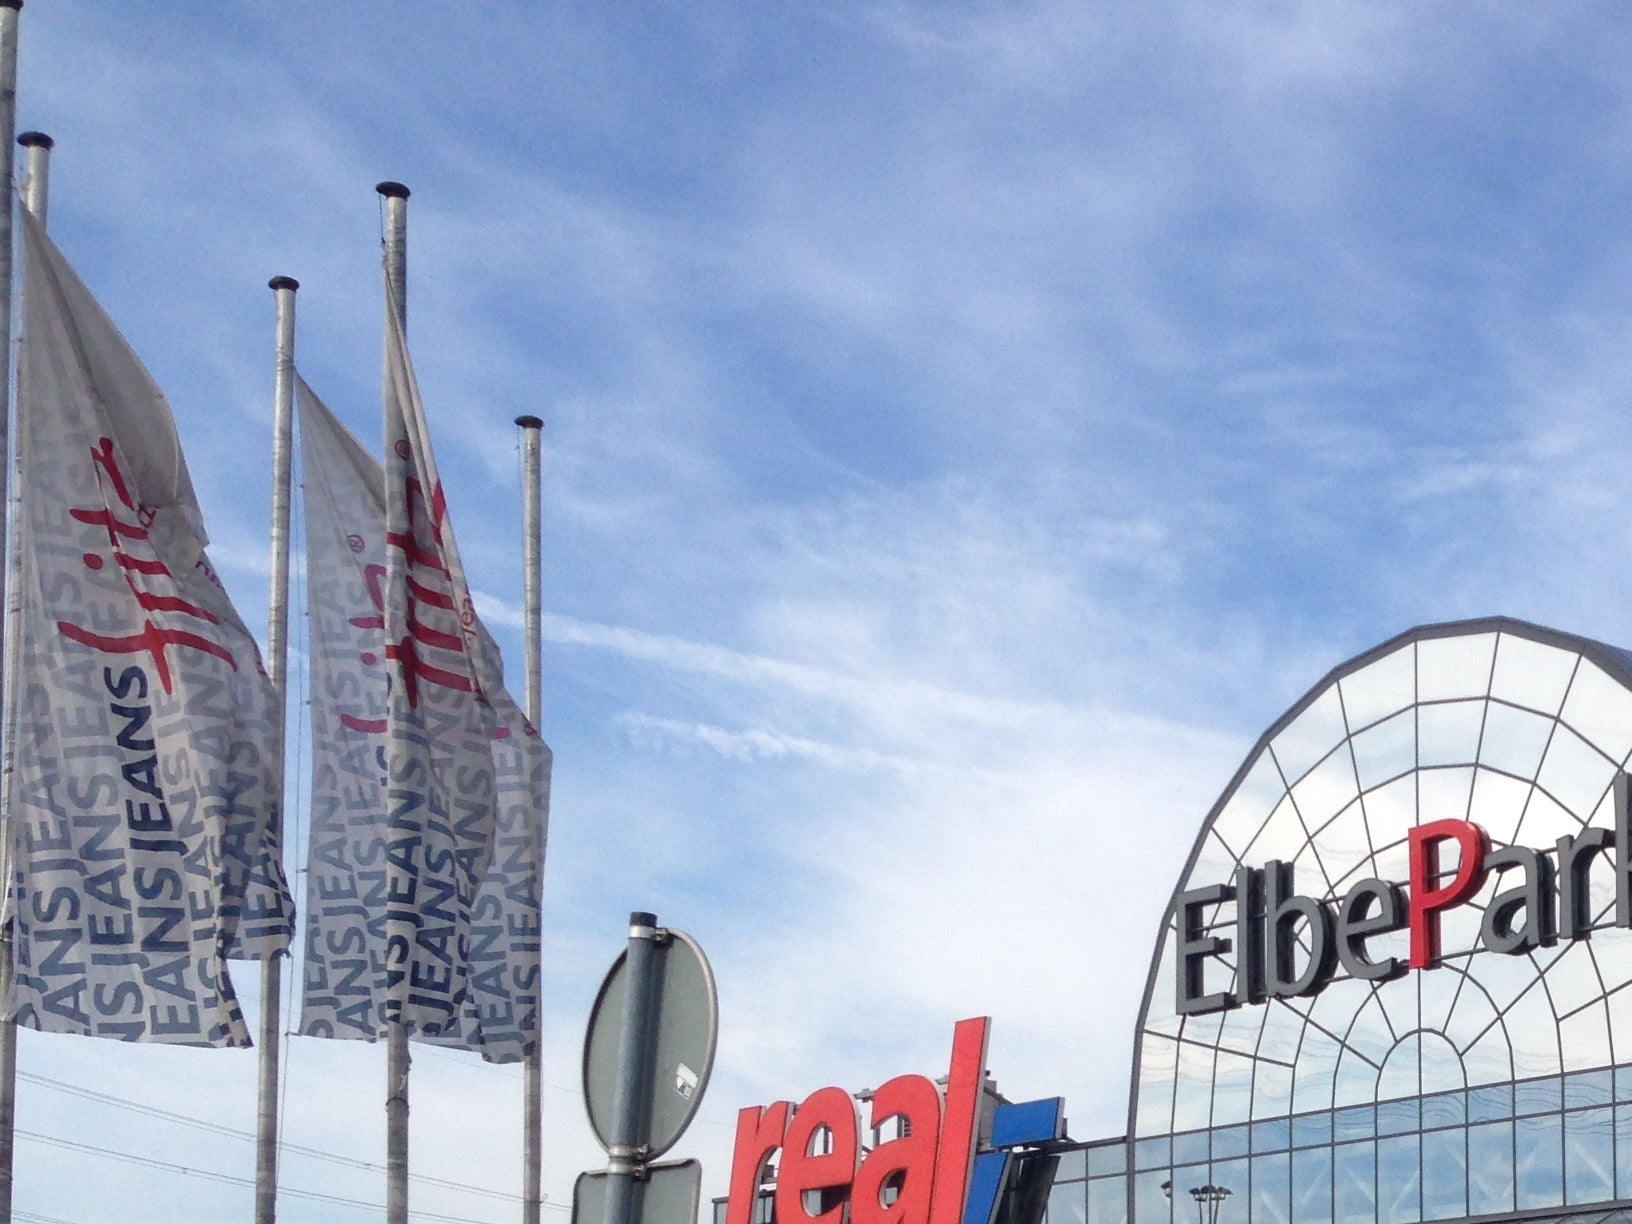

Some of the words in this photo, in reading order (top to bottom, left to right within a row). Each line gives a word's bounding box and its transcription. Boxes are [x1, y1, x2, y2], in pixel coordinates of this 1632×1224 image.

[103, 666, 190, 856] JEANS
[66, 773, 151, 969] JEANS
[132, 867, 201, 1040] EANS
[408, 842, 457, 1020] JEANS
[32, 886, 90, 1037] ANS
[325, 926, 377, 1040] ANS
[469, 894, 524, 1045] JEANS
